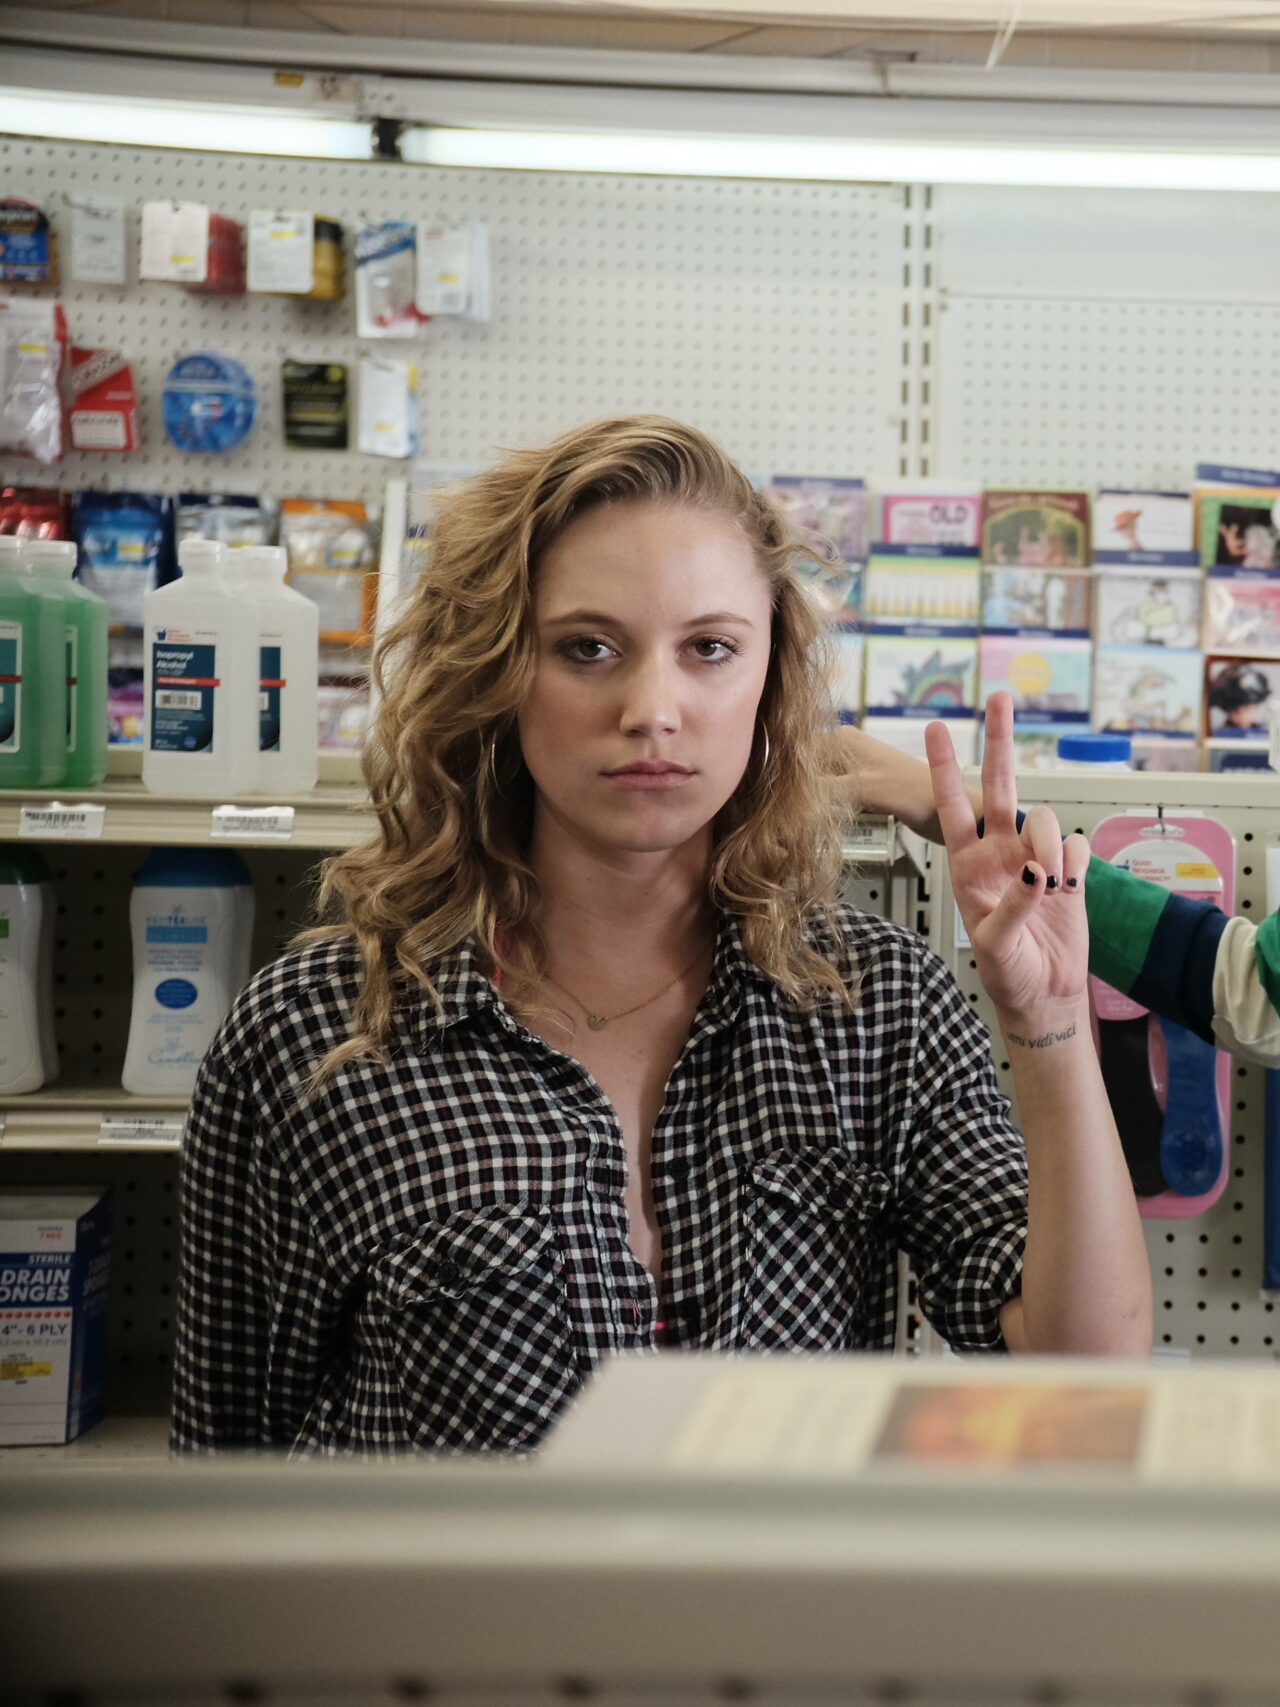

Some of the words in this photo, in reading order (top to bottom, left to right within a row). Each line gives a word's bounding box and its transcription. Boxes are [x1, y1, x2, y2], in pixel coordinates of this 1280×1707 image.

[1029, 1031, 1054, 1049] vidi
[1055, 1022, 1076, 1042] vici
[29, 1254, 71, 1264] STERILE
[1, 1269, 71, 1285] DRAIN
[27, 1324, 35, 1336] 6
[40, 1324, 67, 1336] PLY
